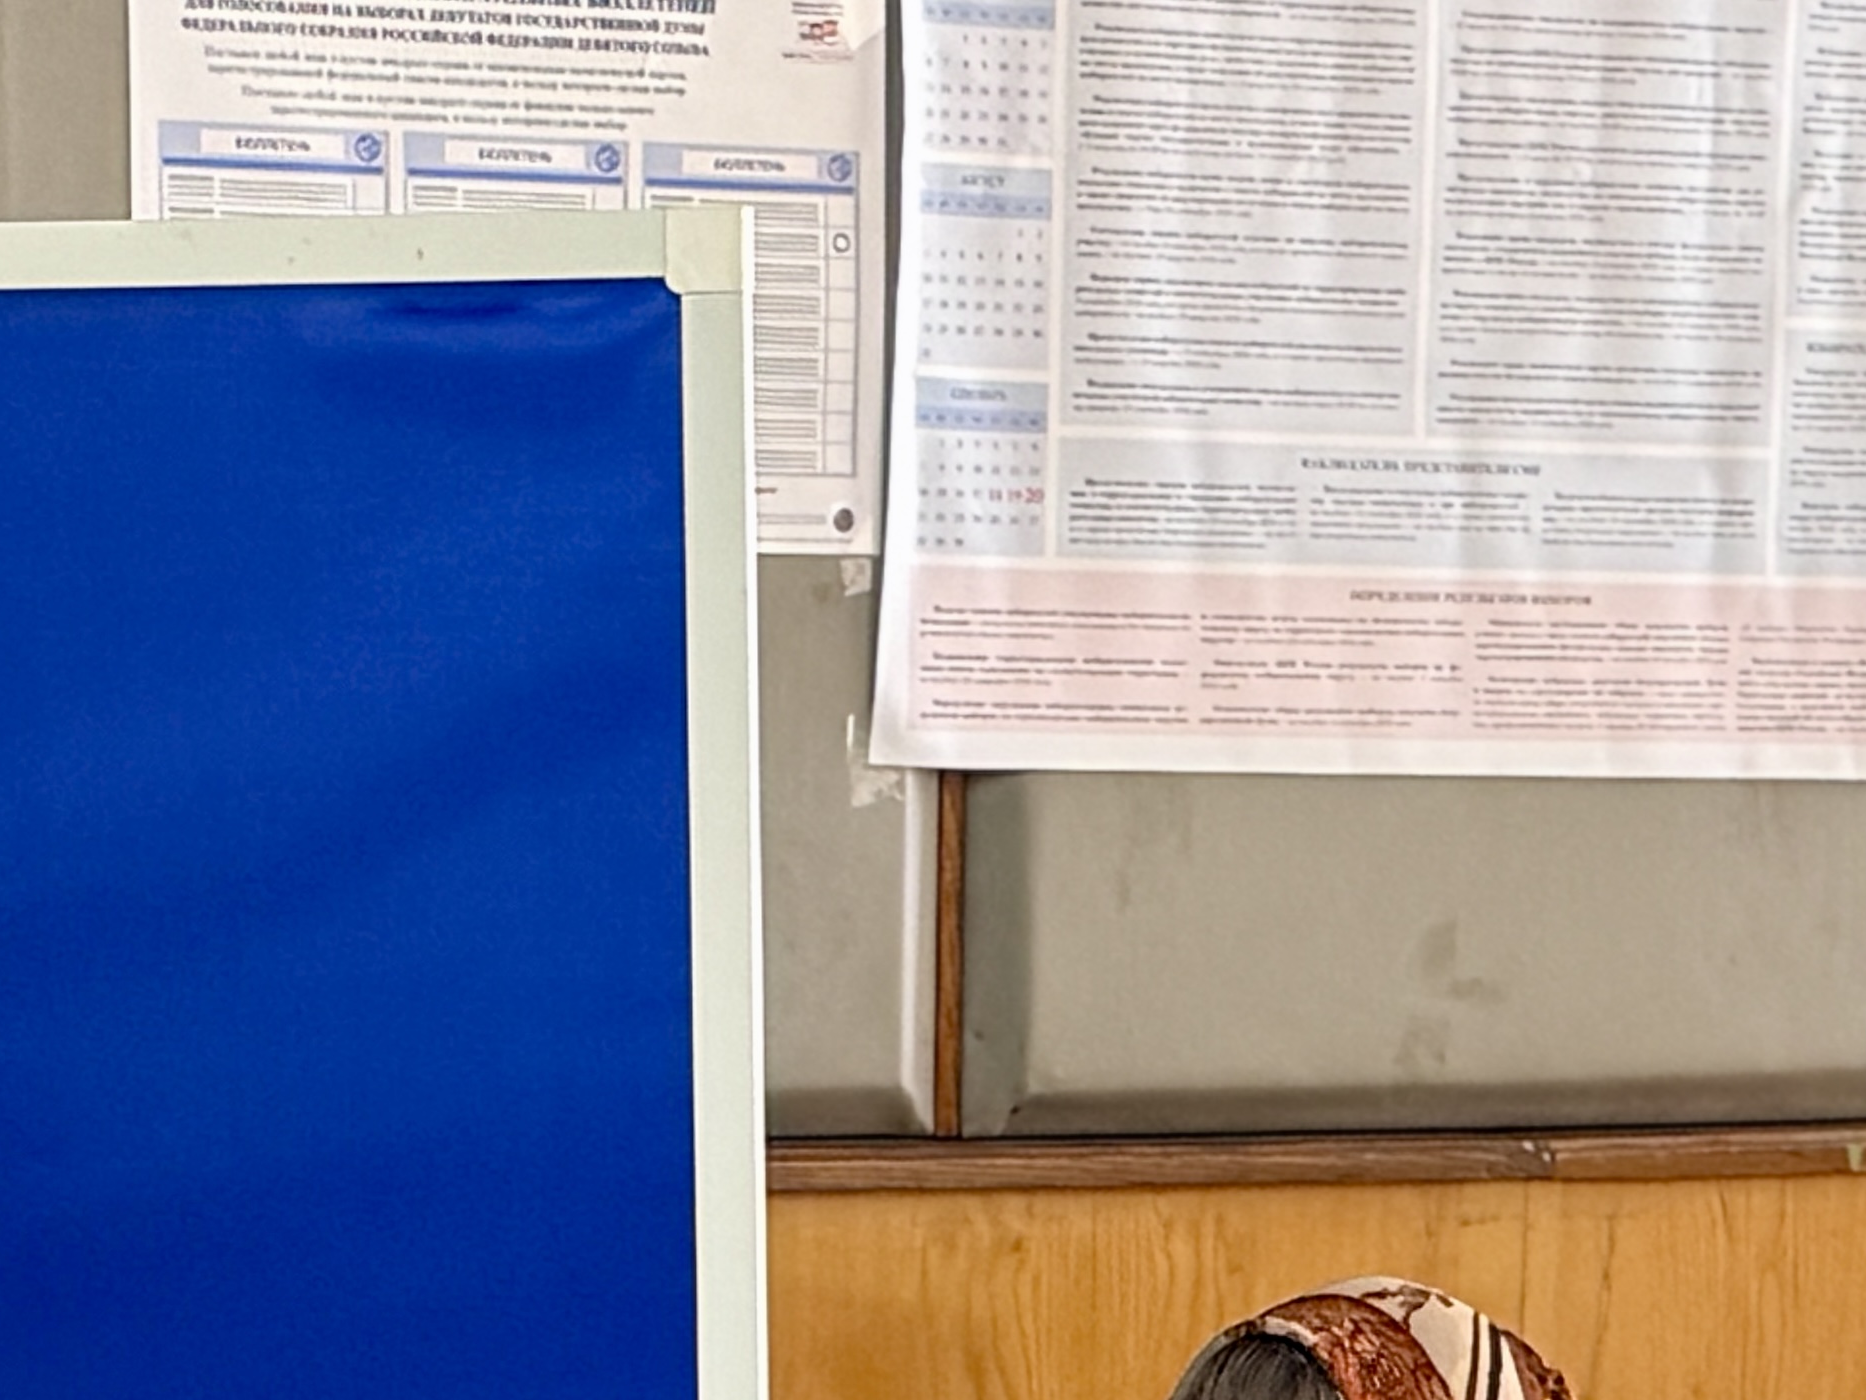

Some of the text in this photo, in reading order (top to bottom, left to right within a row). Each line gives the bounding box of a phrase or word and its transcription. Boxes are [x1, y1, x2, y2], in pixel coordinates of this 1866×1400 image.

[181, 17, 296, 36] ФЕДЕРАЛЬНОГО
[301, 21, 377, 40] СОБРАНИЯ
[382, 26, 483, 45] РОССИЙСКОЙ
[487, 33, 573, 49] ФЕДЕРАЦИИ
[235, 135, 311, 152] БЮЛЛЕТЕНЬ
[478, 147, 552, 164] БЮЛЛЕТЕНЬ
[713, 157, 786, 173] БЮЛЛЕТЕНЬ
